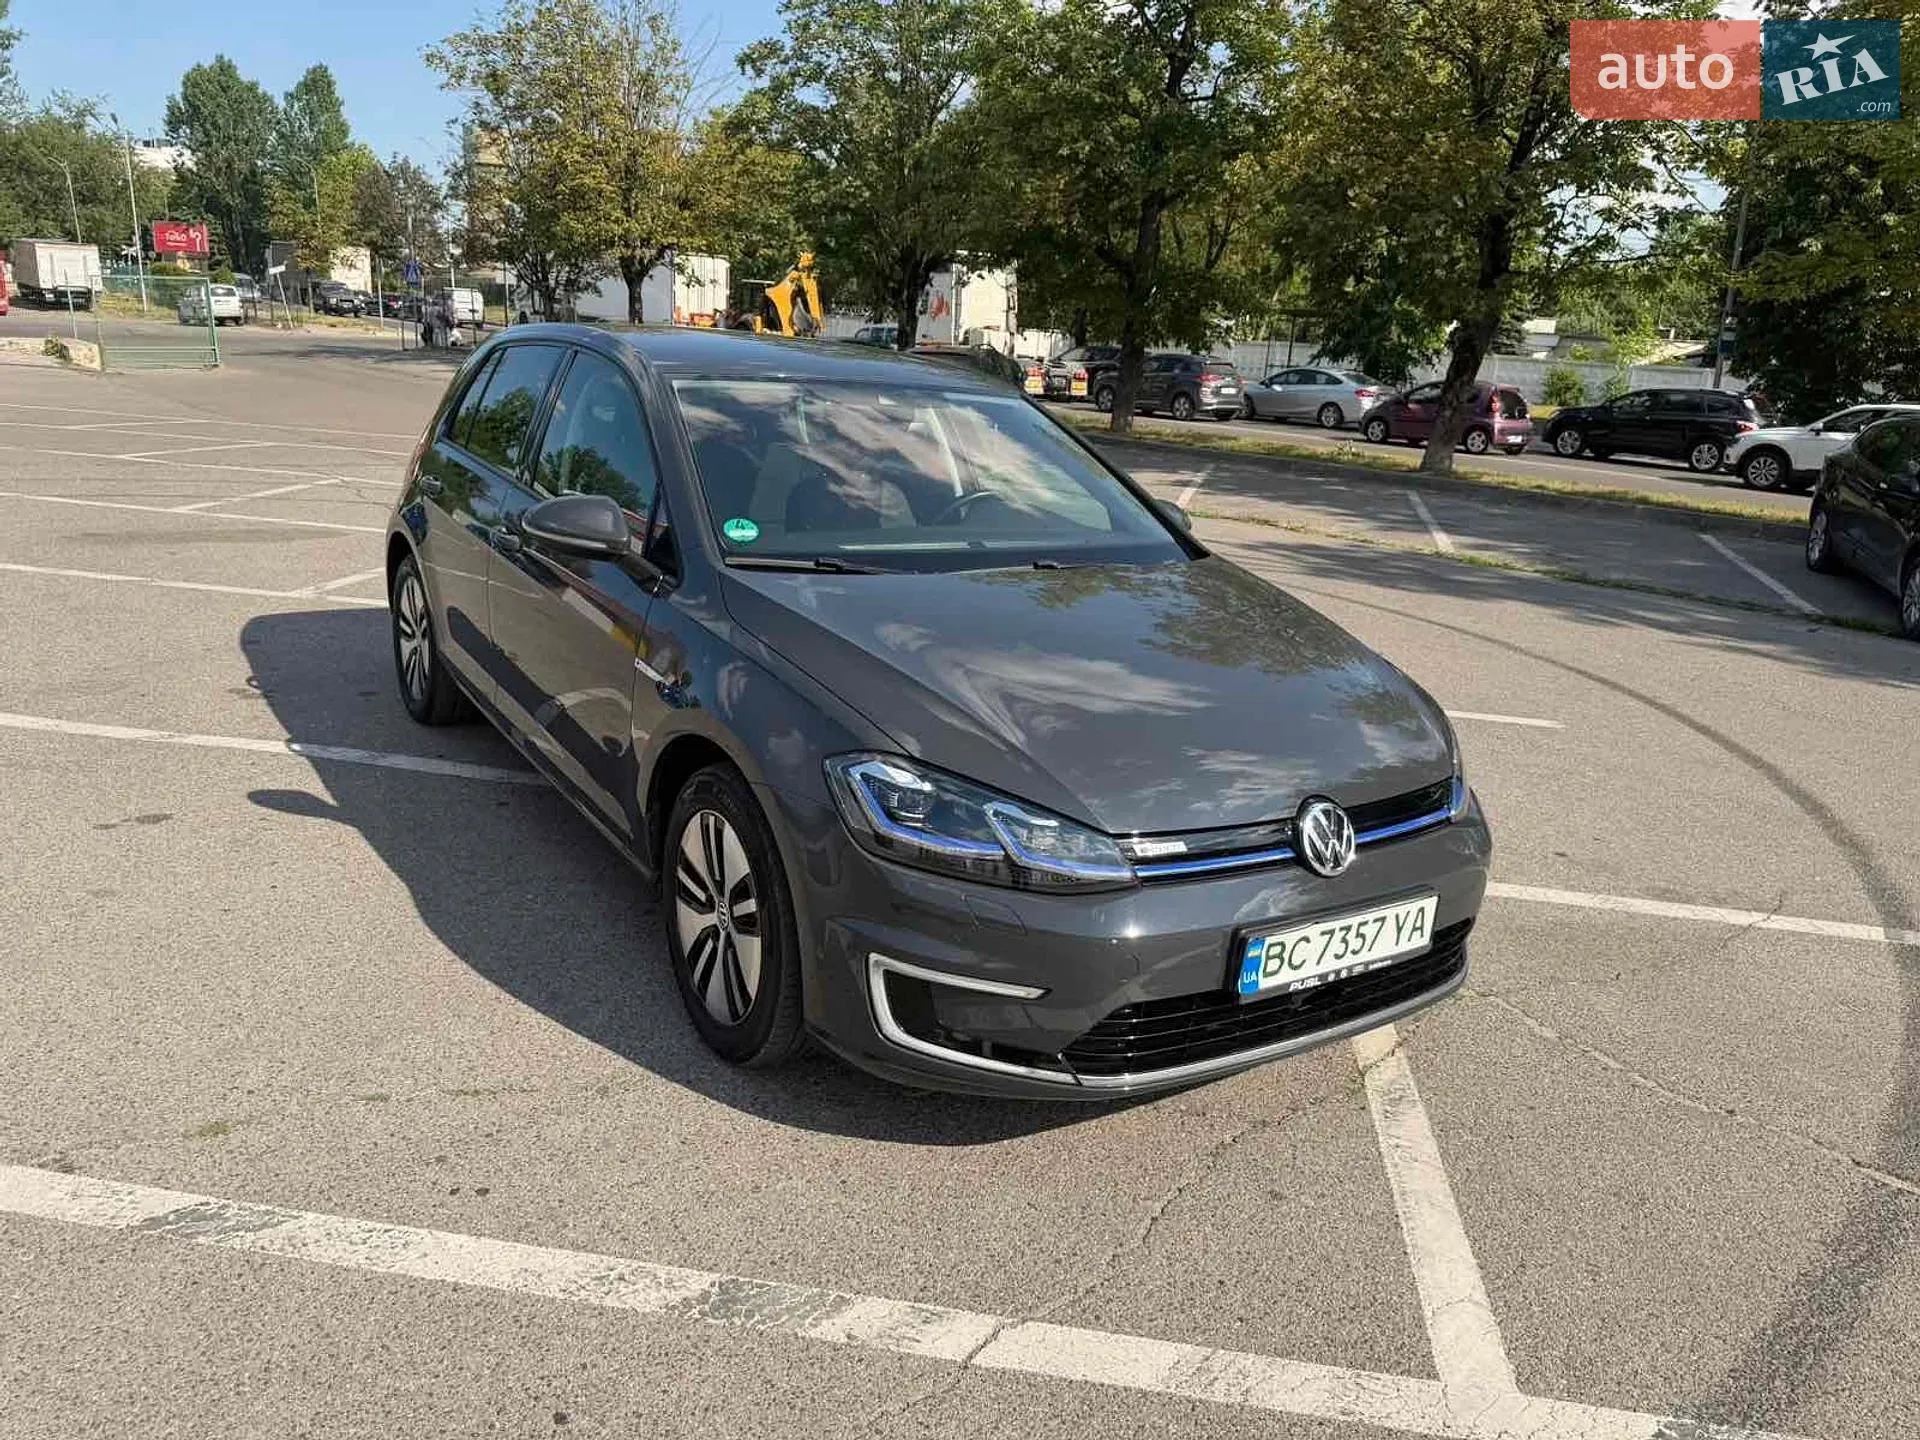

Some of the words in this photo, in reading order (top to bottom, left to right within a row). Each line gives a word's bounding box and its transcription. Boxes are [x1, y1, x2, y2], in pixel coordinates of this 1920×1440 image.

[1262, 937, 1312, 978] BC
[1316, 916, 1387, 966] 7357
[1394, 906, 1425, 946] YA
[1243, 971, 1258, 984] UA
